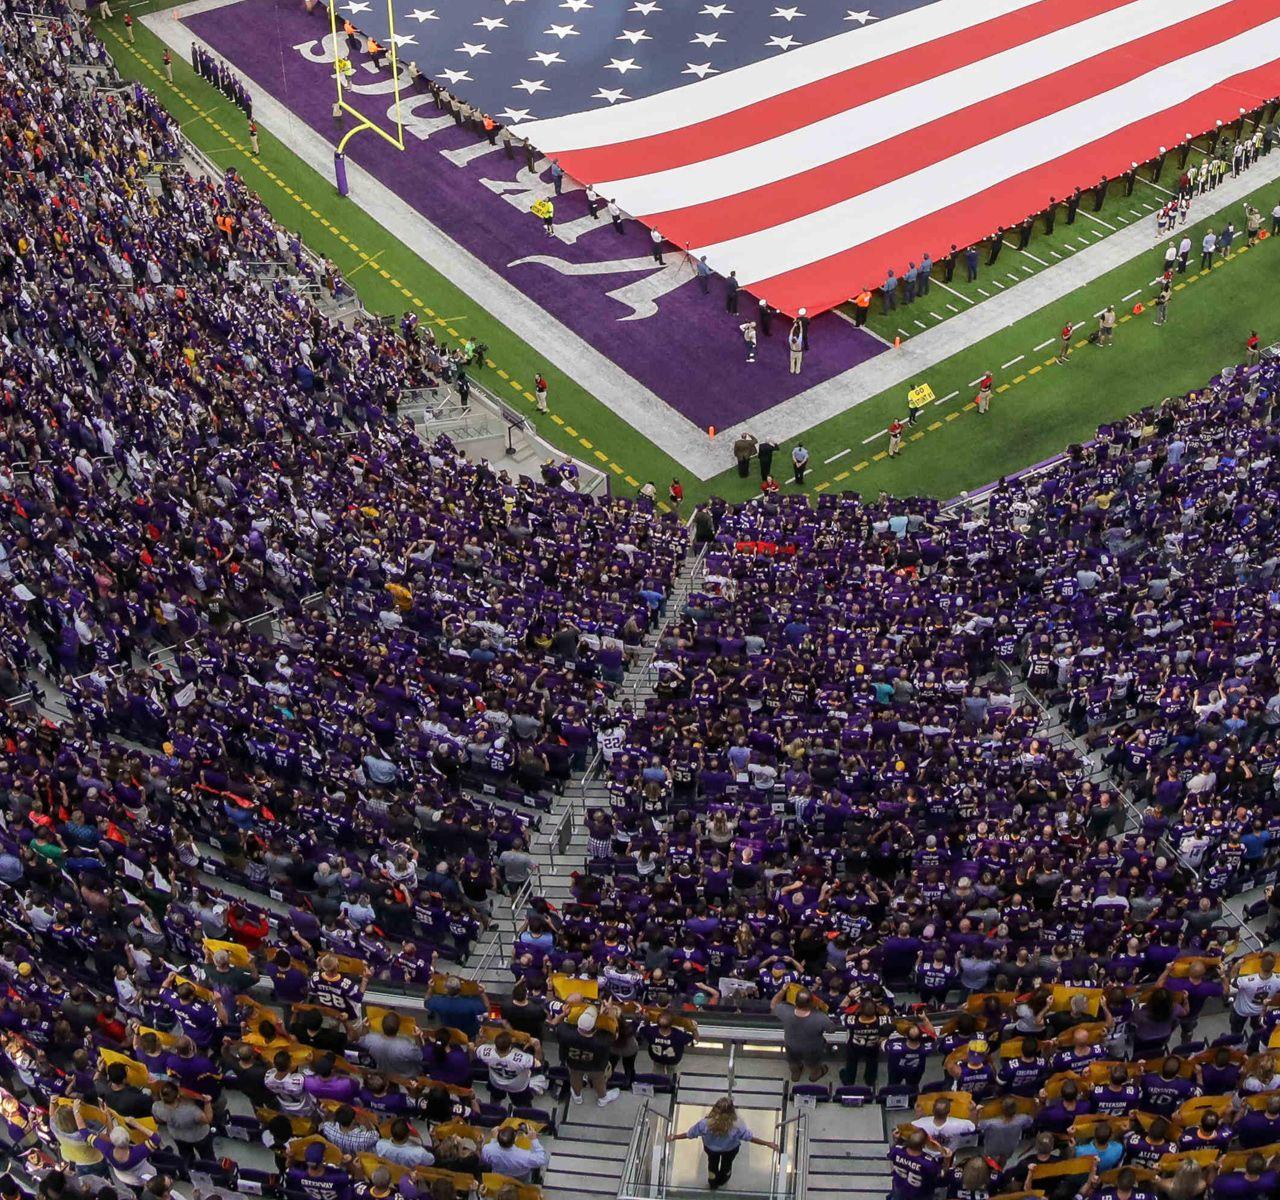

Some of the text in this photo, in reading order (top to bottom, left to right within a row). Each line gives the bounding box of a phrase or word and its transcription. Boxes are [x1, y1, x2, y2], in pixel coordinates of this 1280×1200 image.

[605, 736, 623, 749] 22
[316, 992, 347, 1009] 28
[483, 1046, 524, 1063] 55 55
